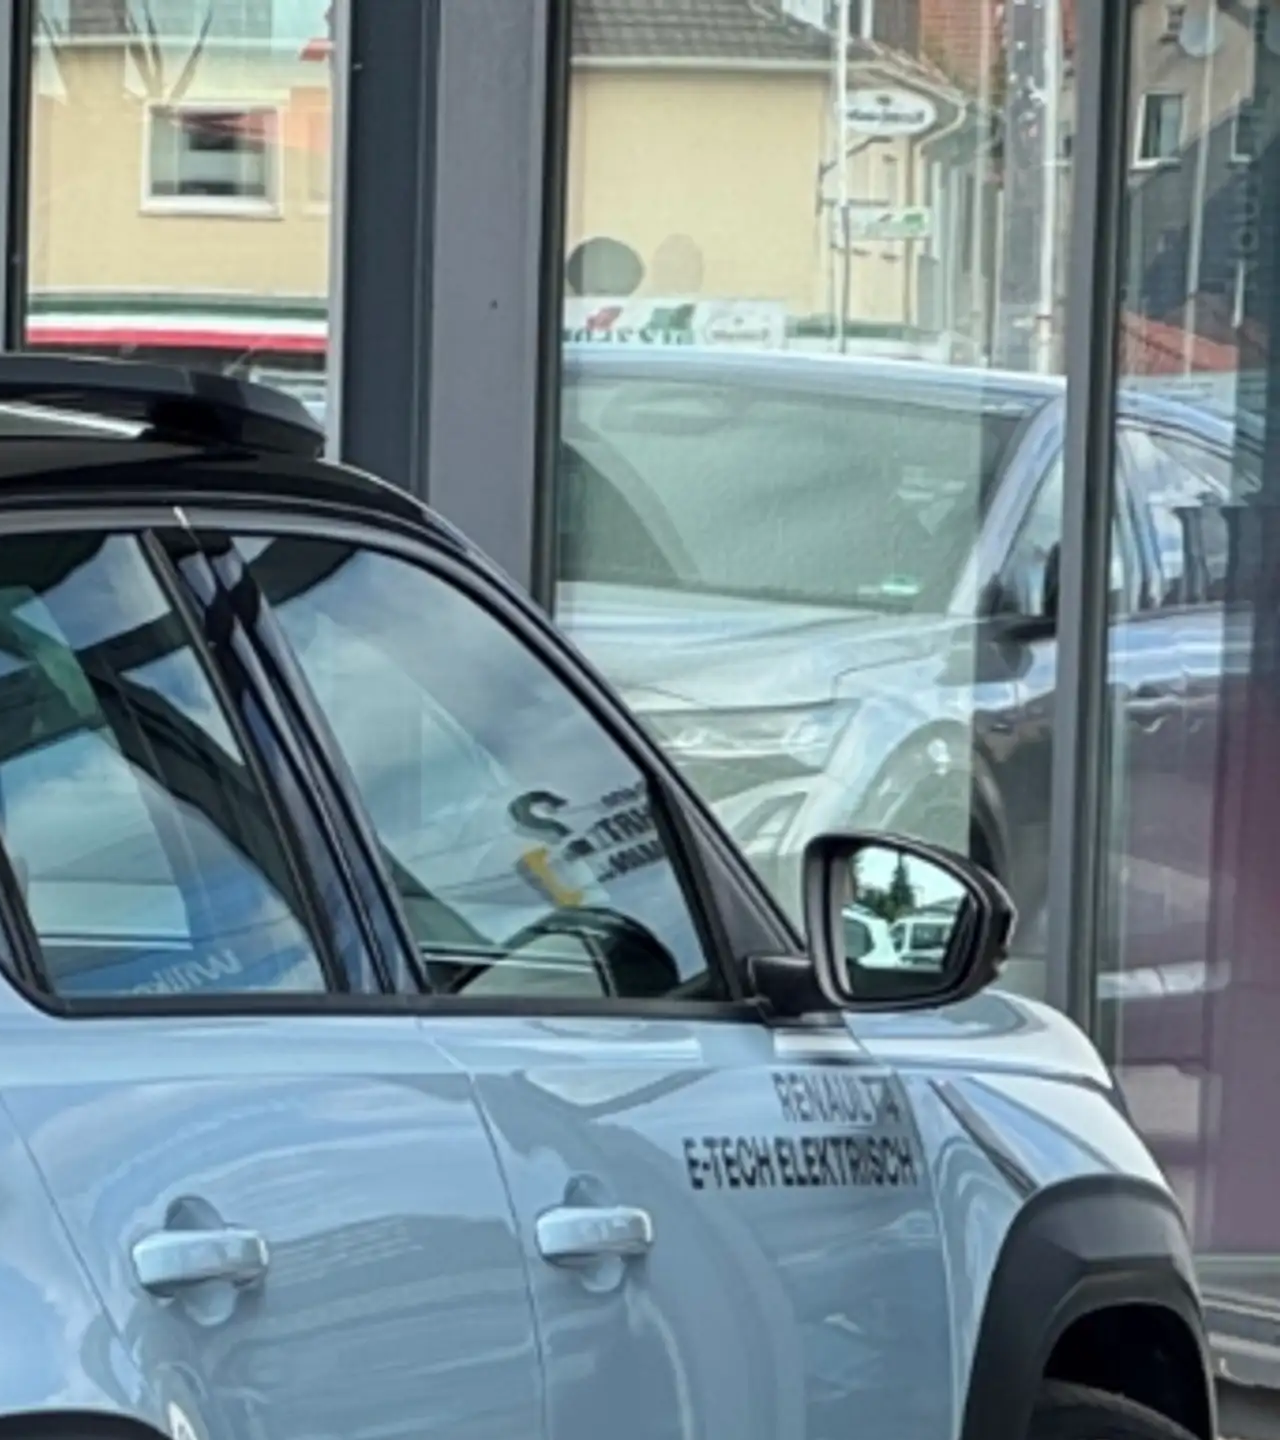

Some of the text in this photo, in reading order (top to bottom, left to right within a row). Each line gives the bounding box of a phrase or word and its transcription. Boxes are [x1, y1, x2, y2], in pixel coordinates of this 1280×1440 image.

[771, 1072, 884, 1123] RENAULT
[682, 1135, 918, 1190] E-TECH ELEKTRISCH
